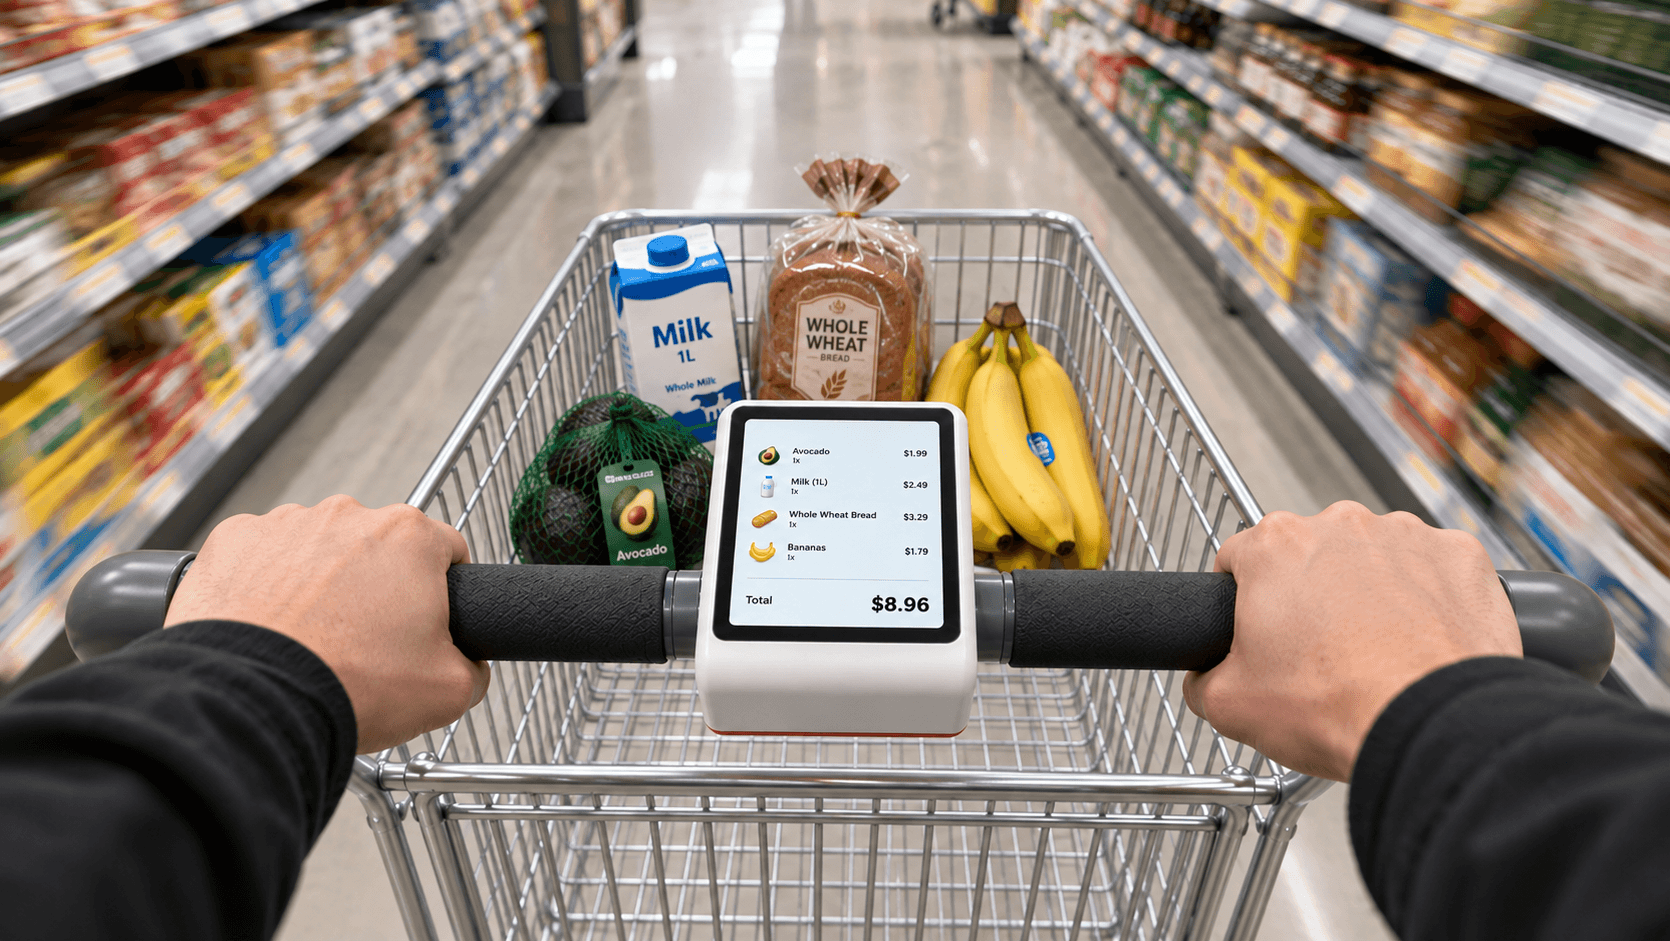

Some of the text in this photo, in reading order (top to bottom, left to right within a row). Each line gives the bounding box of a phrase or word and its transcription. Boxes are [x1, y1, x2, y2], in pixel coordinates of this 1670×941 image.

[653, 317, 713, 348] Milk
[806, 317, 868, 335] WHOLE
[806, 335, 867, 352] WHEAT
[677, 349, 695, 363] 1L
[821, 354, 850, 362] BREAD
[665, 377, 717, 393] Whole Milk
[792, 447, 831, 455] Avocado
[812, 478, 827, 486] (1L)
[904, 513, 928, 521] $3.29
[617, 544, 667, 561] Avocado
[905, 547, 928, 555] $1.79
[746, 596, 772, 604] Total
[872, 595, 929, 613] $8.96
